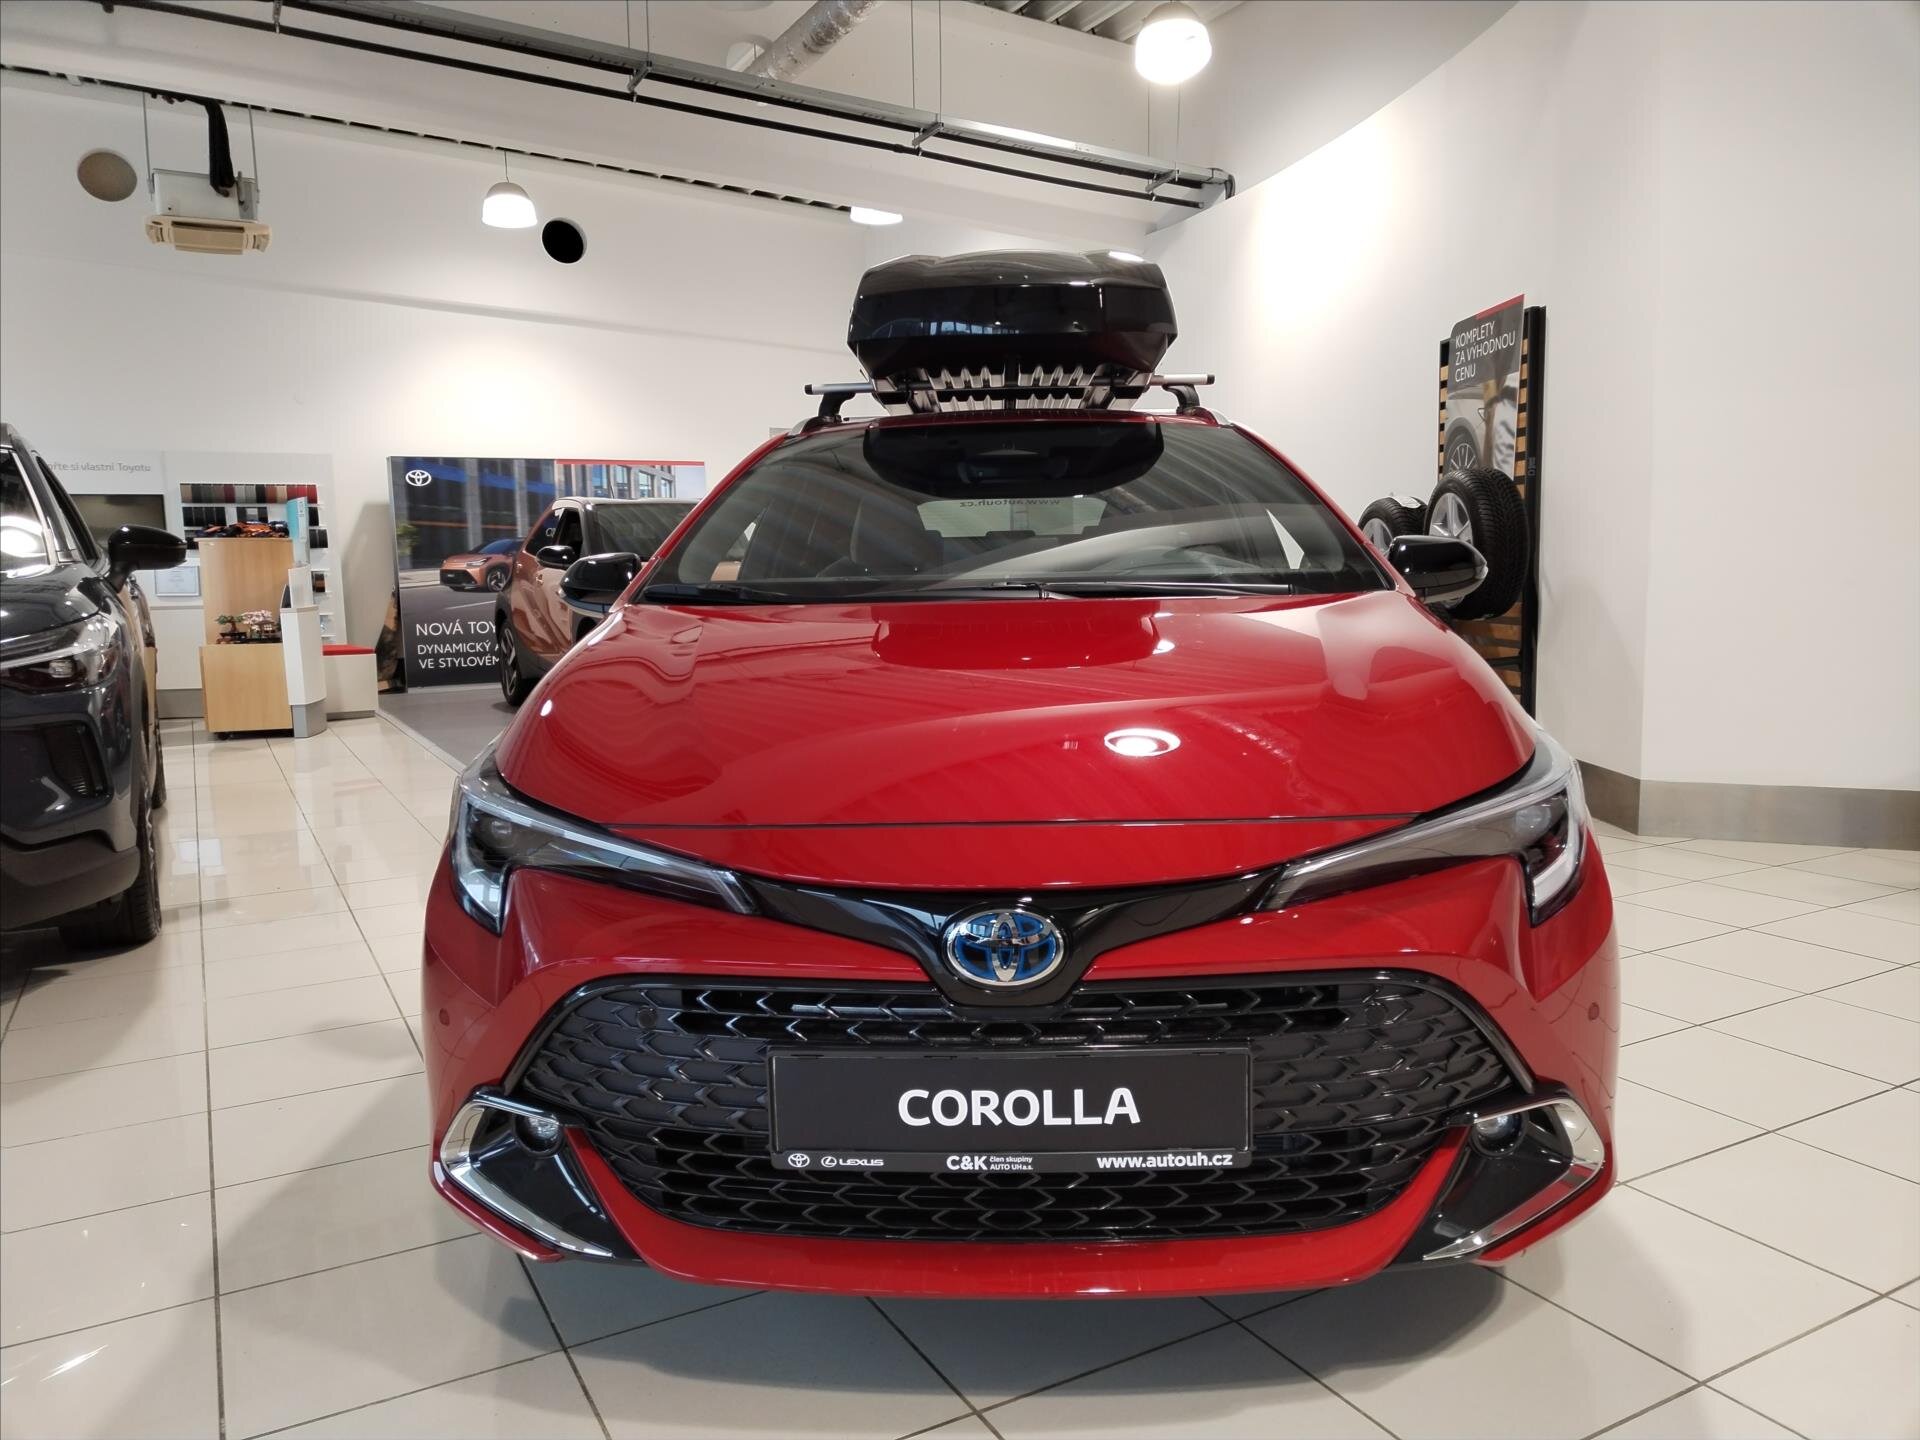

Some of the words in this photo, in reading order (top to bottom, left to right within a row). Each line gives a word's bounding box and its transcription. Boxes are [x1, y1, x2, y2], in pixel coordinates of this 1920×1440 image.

[1455, 321, 1495, 349] KOMPLETY
[1455, 351, 1466, 366] ZA
[1466, 330, 1516, 361] VÝHODNOU
[1455, 364, 1476, 382] CENU
[416, 619, 463, 636] NOVÁ
[467, 620, 496, 634] TOY
[417, 639, 491, 655] DYNAMICKÝ
[418, 658, 435, 669] VE
[898, 1087, 1141, 1127] COROLLA
[839, 1157, 885, 1167] LEXUS
[946, 1155, 988, 1171] C&K
[1005, 1155, 1033, 1163] skupiny
[1096, 1151, 1233, 1169] www.autouh.cz
